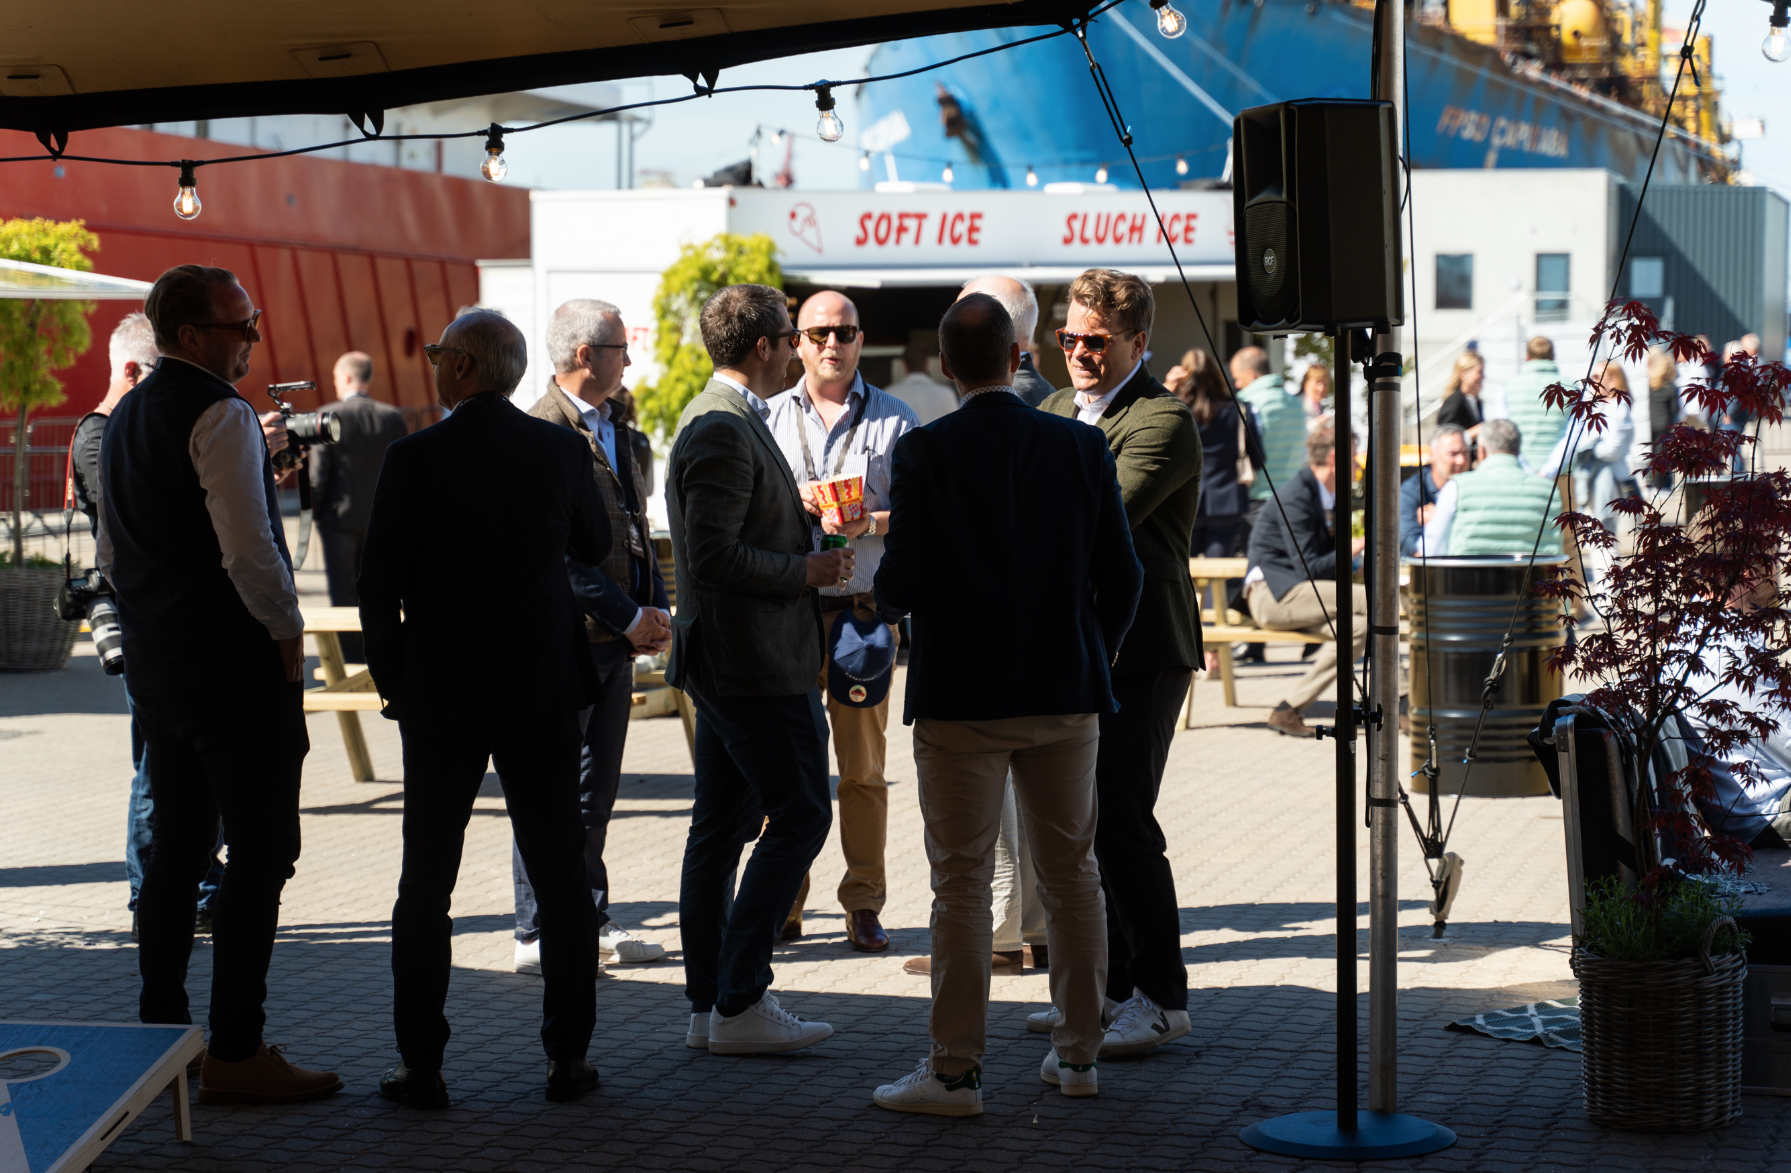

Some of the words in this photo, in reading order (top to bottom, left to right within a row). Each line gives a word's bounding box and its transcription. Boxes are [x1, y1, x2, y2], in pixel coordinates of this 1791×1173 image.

[855, 212, 928, 246] SOFT
[938, 212, 983, 246] ICE
[1062, 212, 1146, 245] SLUCH
[1156, 212, 1198, 245] ICE
[1265, 256, 1275, 266] RCF
